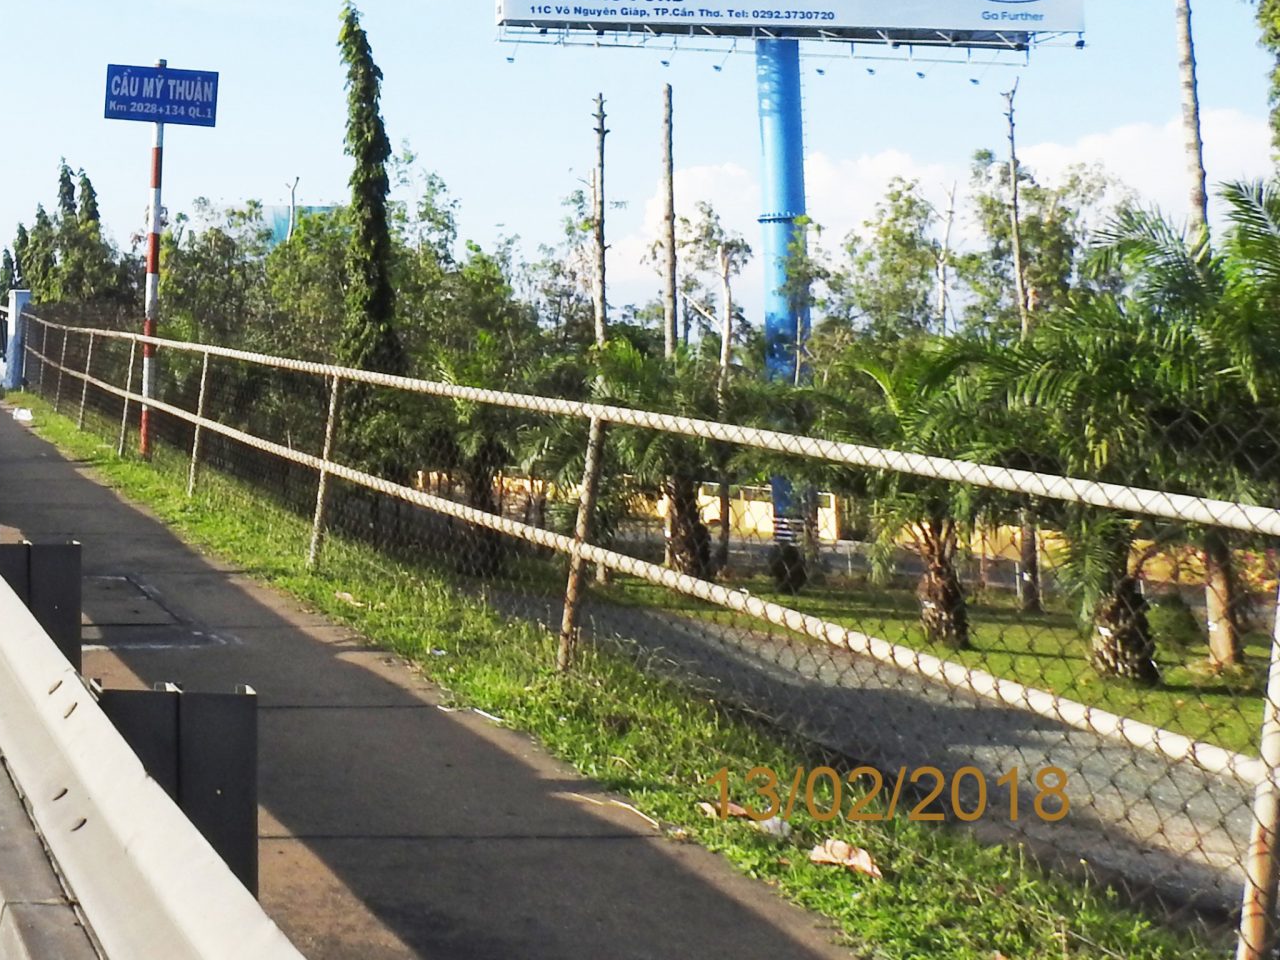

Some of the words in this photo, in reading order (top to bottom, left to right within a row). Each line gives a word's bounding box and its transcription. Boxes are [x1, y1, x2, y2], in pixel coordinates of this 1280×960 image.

[530, 6, 551, 14] 11C
[727, 9, 749, 18] Tel:
[752, 10, 835, 20] 0292.3730720
[981, 11, 999, 20] Go
[1001, 11, 1045, 21] Further
[111, 69, 139, 97] CẦU
[142, 75, 165, 99] MỸ
[168, 77, 213, 105] THUẬN
[109, 100, 126, 111] Km
[188, 107, 212, 118] QL.1
